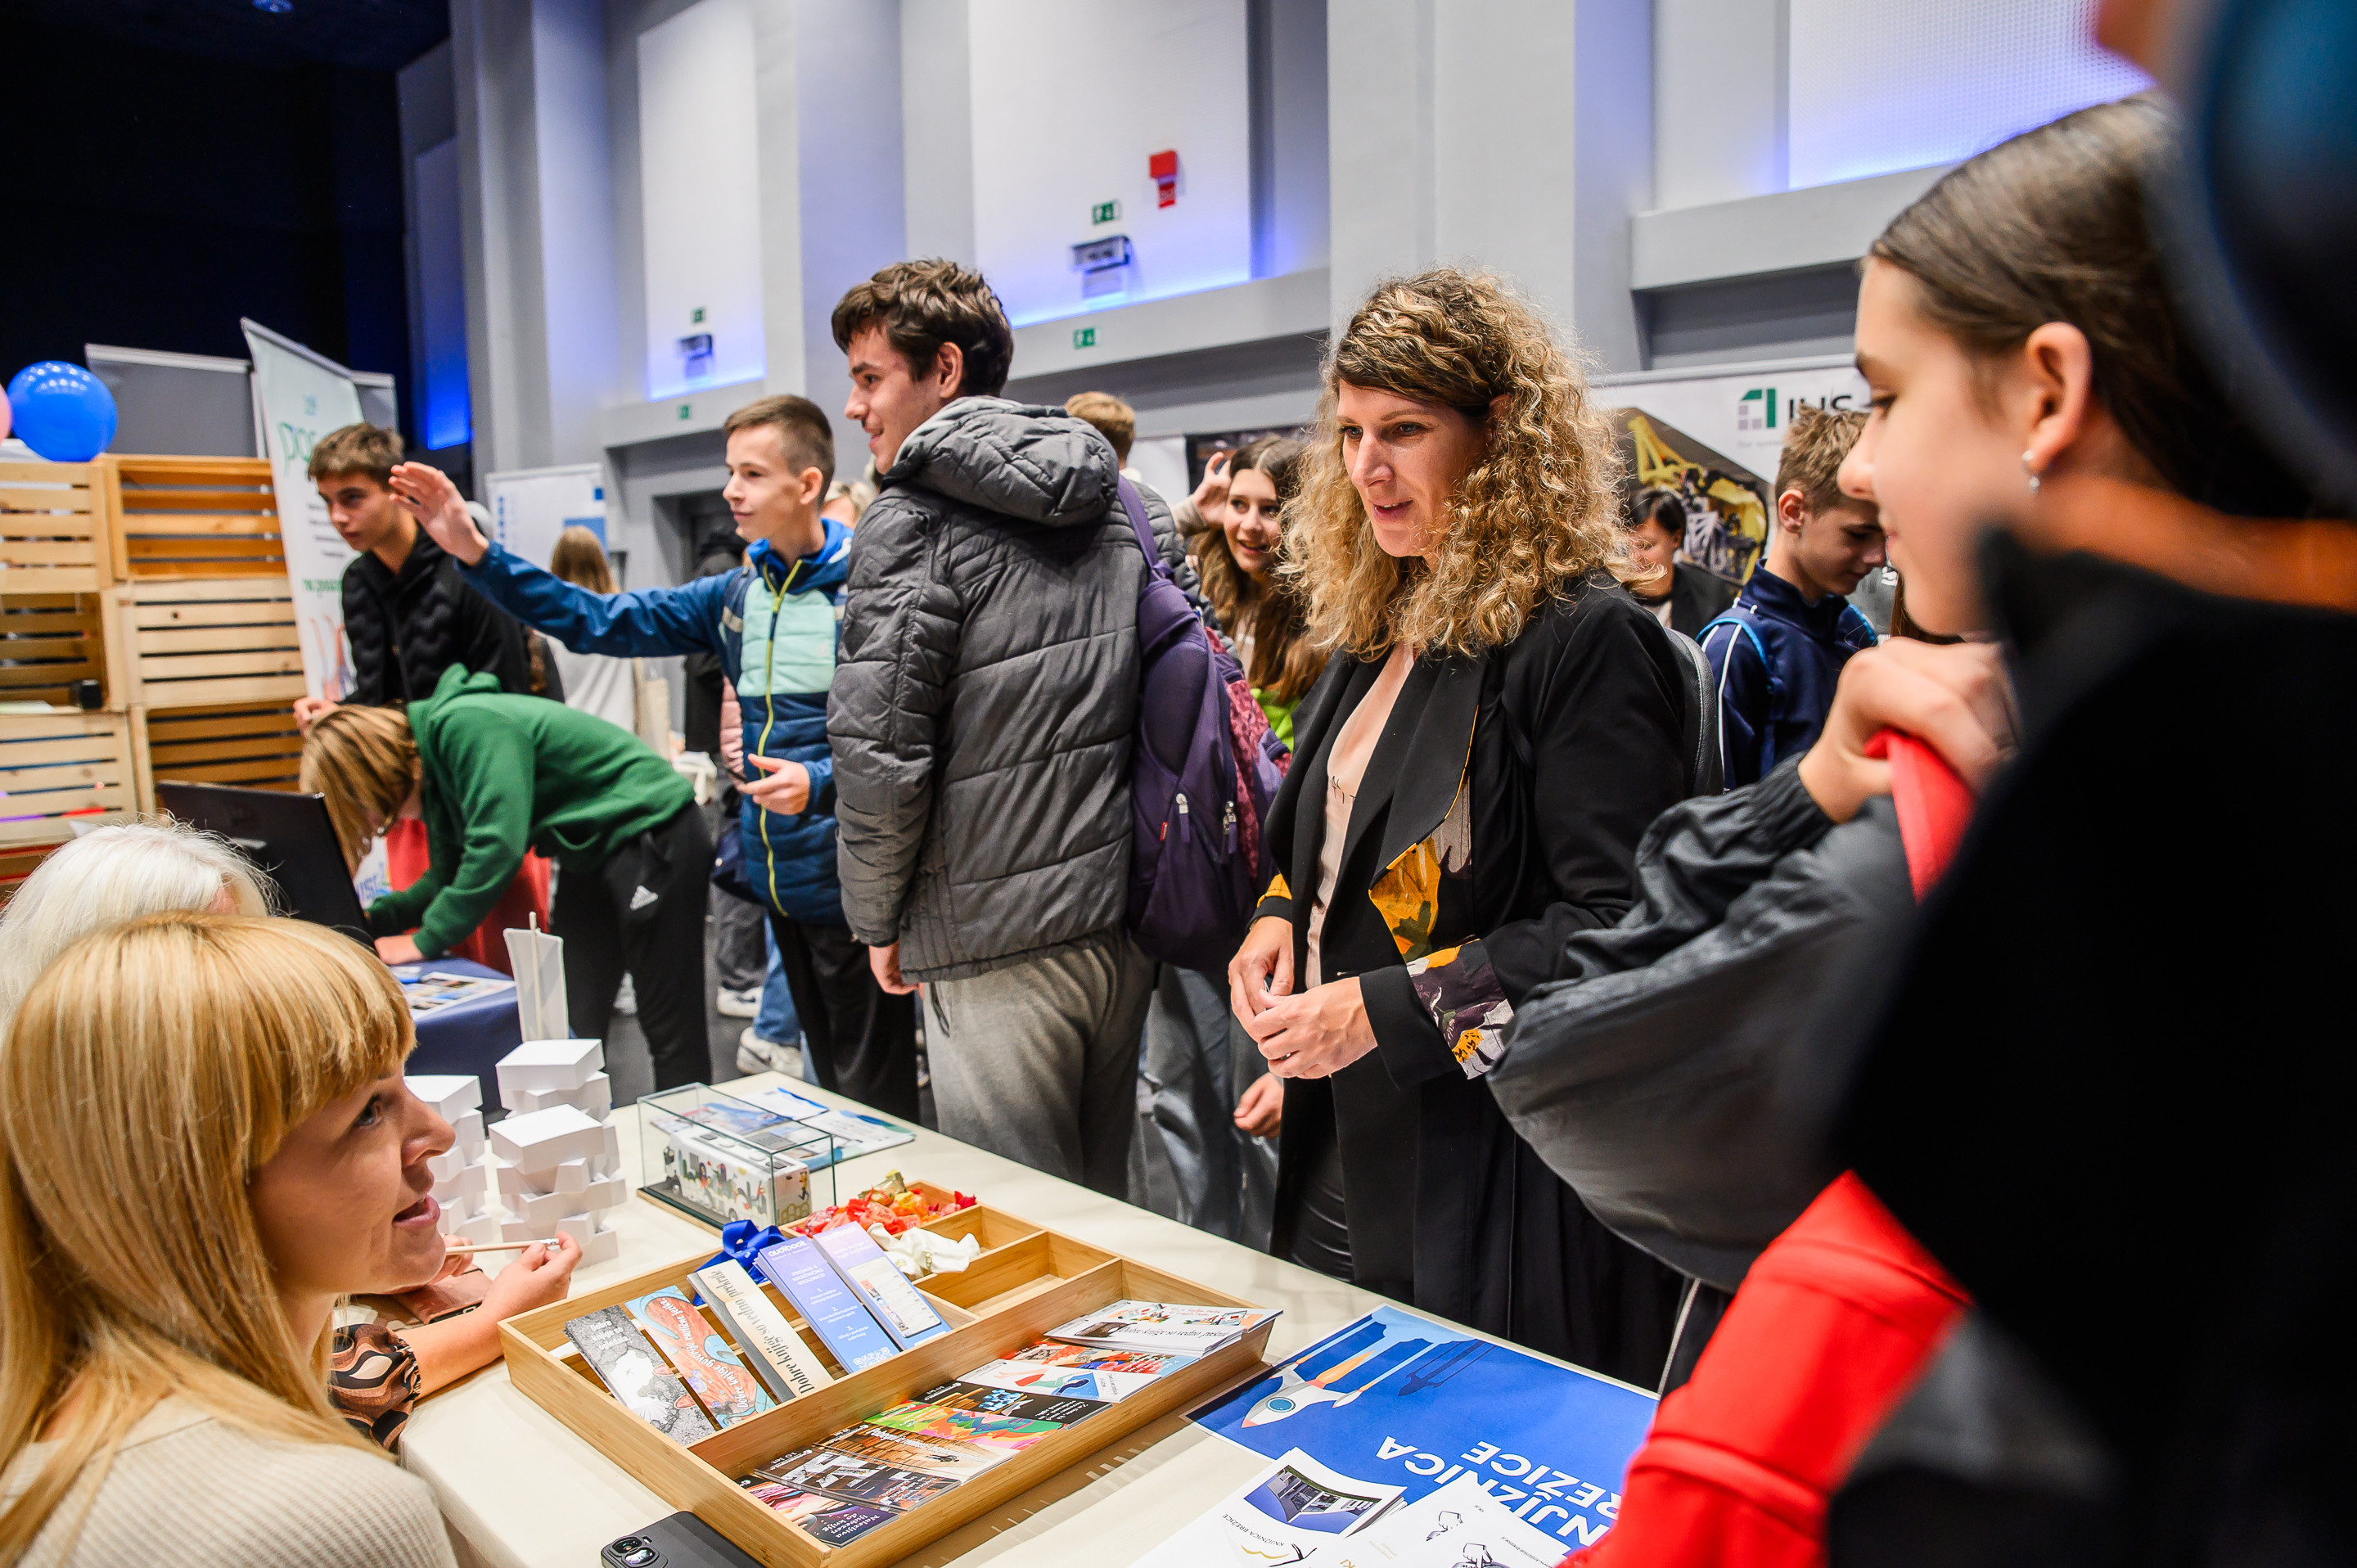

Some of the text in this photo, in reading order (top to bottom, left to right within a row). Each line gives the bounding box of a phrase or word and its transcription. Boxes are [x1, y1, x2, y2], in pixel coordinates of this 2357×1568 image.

[768, 1239, 808, 1257] audibook
[735, 1298, 759, 1326] vedno
[589, 1320, 613, 1331] Dobre
[591, 1330, 615, 1341] knjige
[756, 1324, 770, 1336] so
[686, 1343, 714, 1367] govorijo
[764, 1336, 792, 1365] knjige
[714, 1364, 738, 1386] knjige
[786, 1363, 815, 1394] Dobre
[734, 1386, 749, 1407] Dobre
[1461, 1440, 1623, 1521] REŽICE
[822, 1512, 859, 1532] do knjig
[831, 1514, 869, 1534] ljubezen
[835, 1514, 881, 1539] Nalezljiva
[1222, 1513, 1285, 1548] KNJIŽNICA BREŽICE
